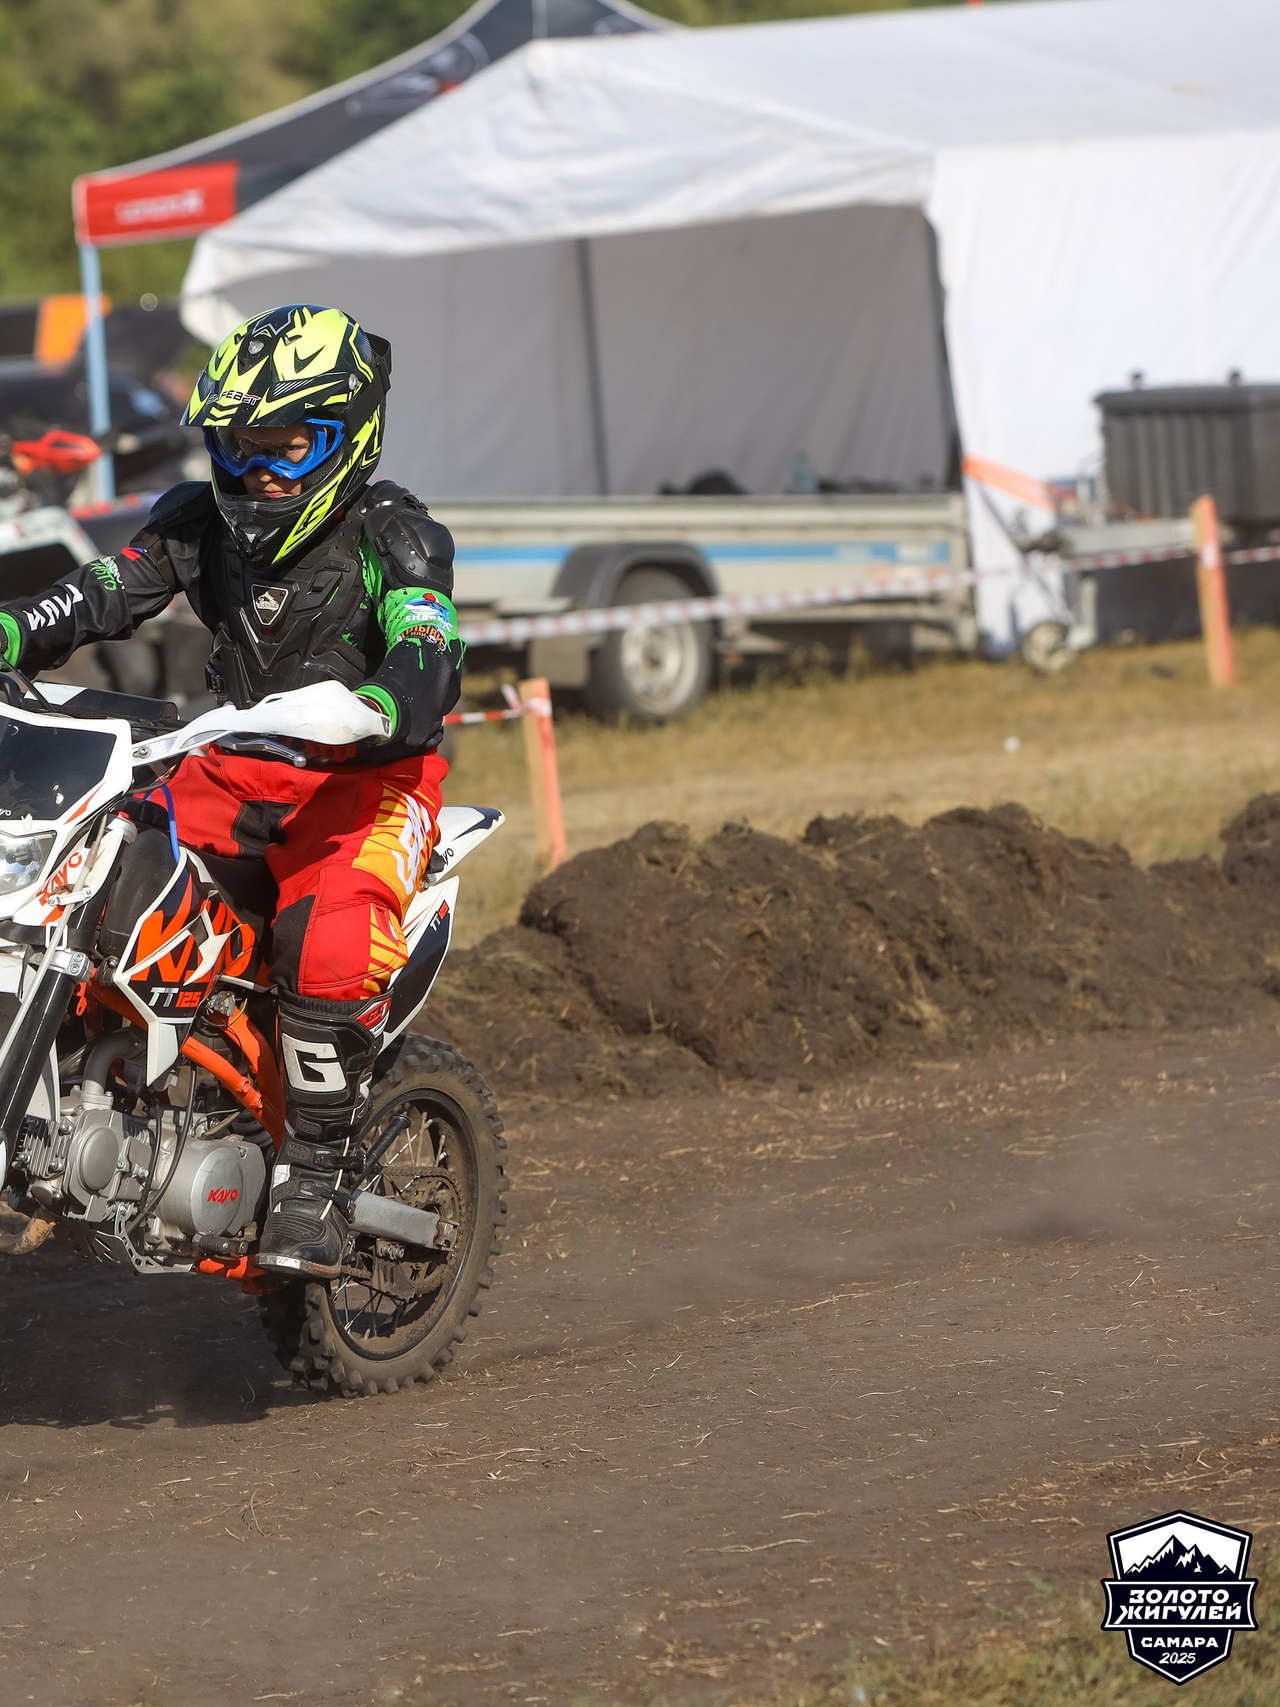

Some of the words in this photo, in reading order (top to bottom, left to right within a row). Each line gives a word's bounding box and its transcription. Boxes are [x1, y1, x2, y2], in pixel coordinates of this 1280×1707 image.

[148, 986, 180, 1008] TT
[175, 991, 203, 1008] 125
[281, 1032, 348, 1093] G
[207, 1186, 239, 1205] KAYO
